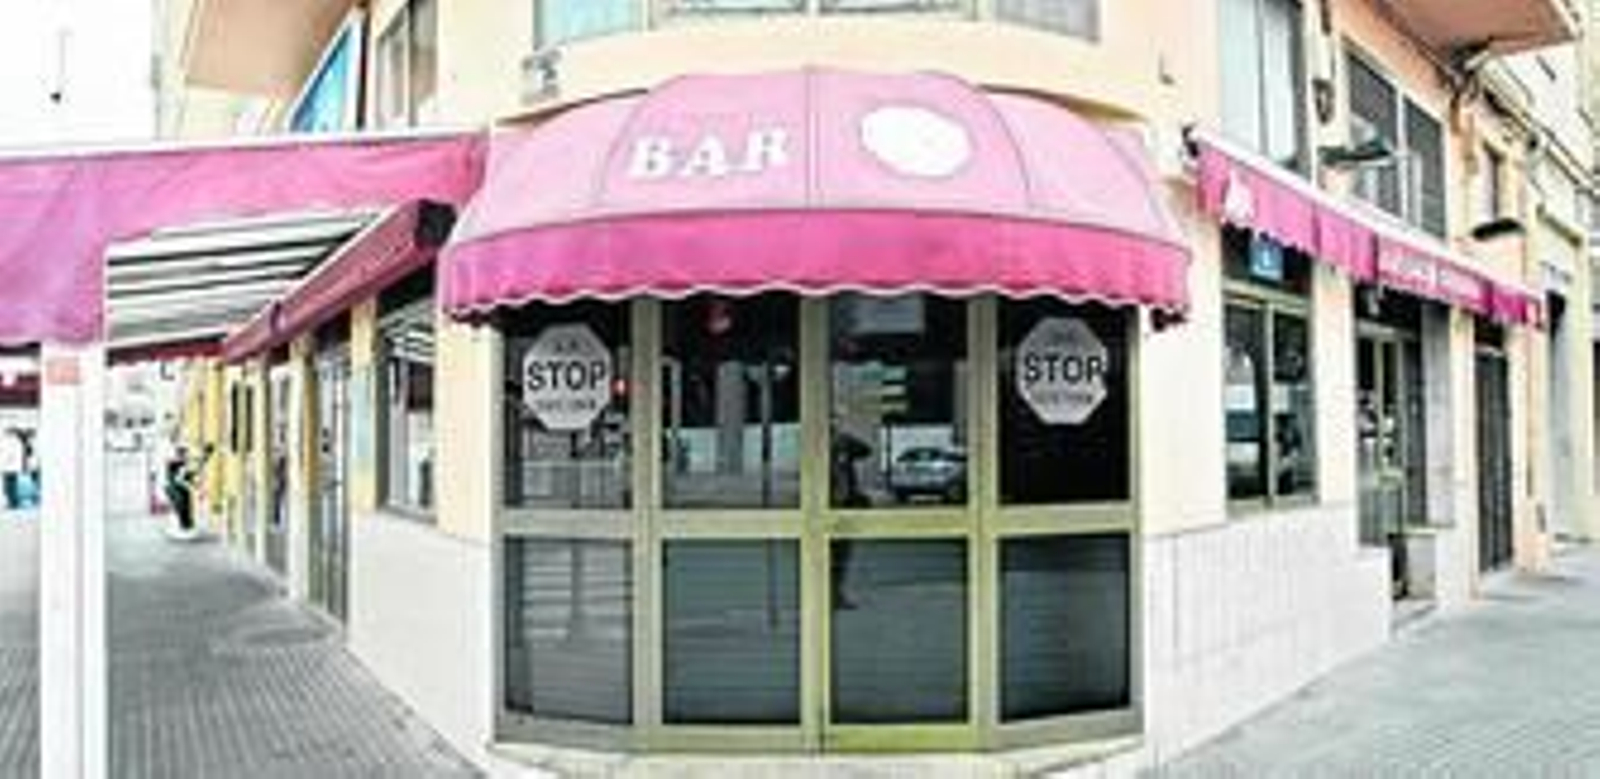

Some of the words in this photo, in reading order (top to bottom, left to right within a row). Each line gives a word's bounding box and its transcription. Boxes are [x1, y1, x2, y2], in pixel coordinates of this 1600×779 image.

[628, 127, 791, 180] BAR
[526, 360, 606, 392] STOP
[1024, 353, 1105, 385] STOP
